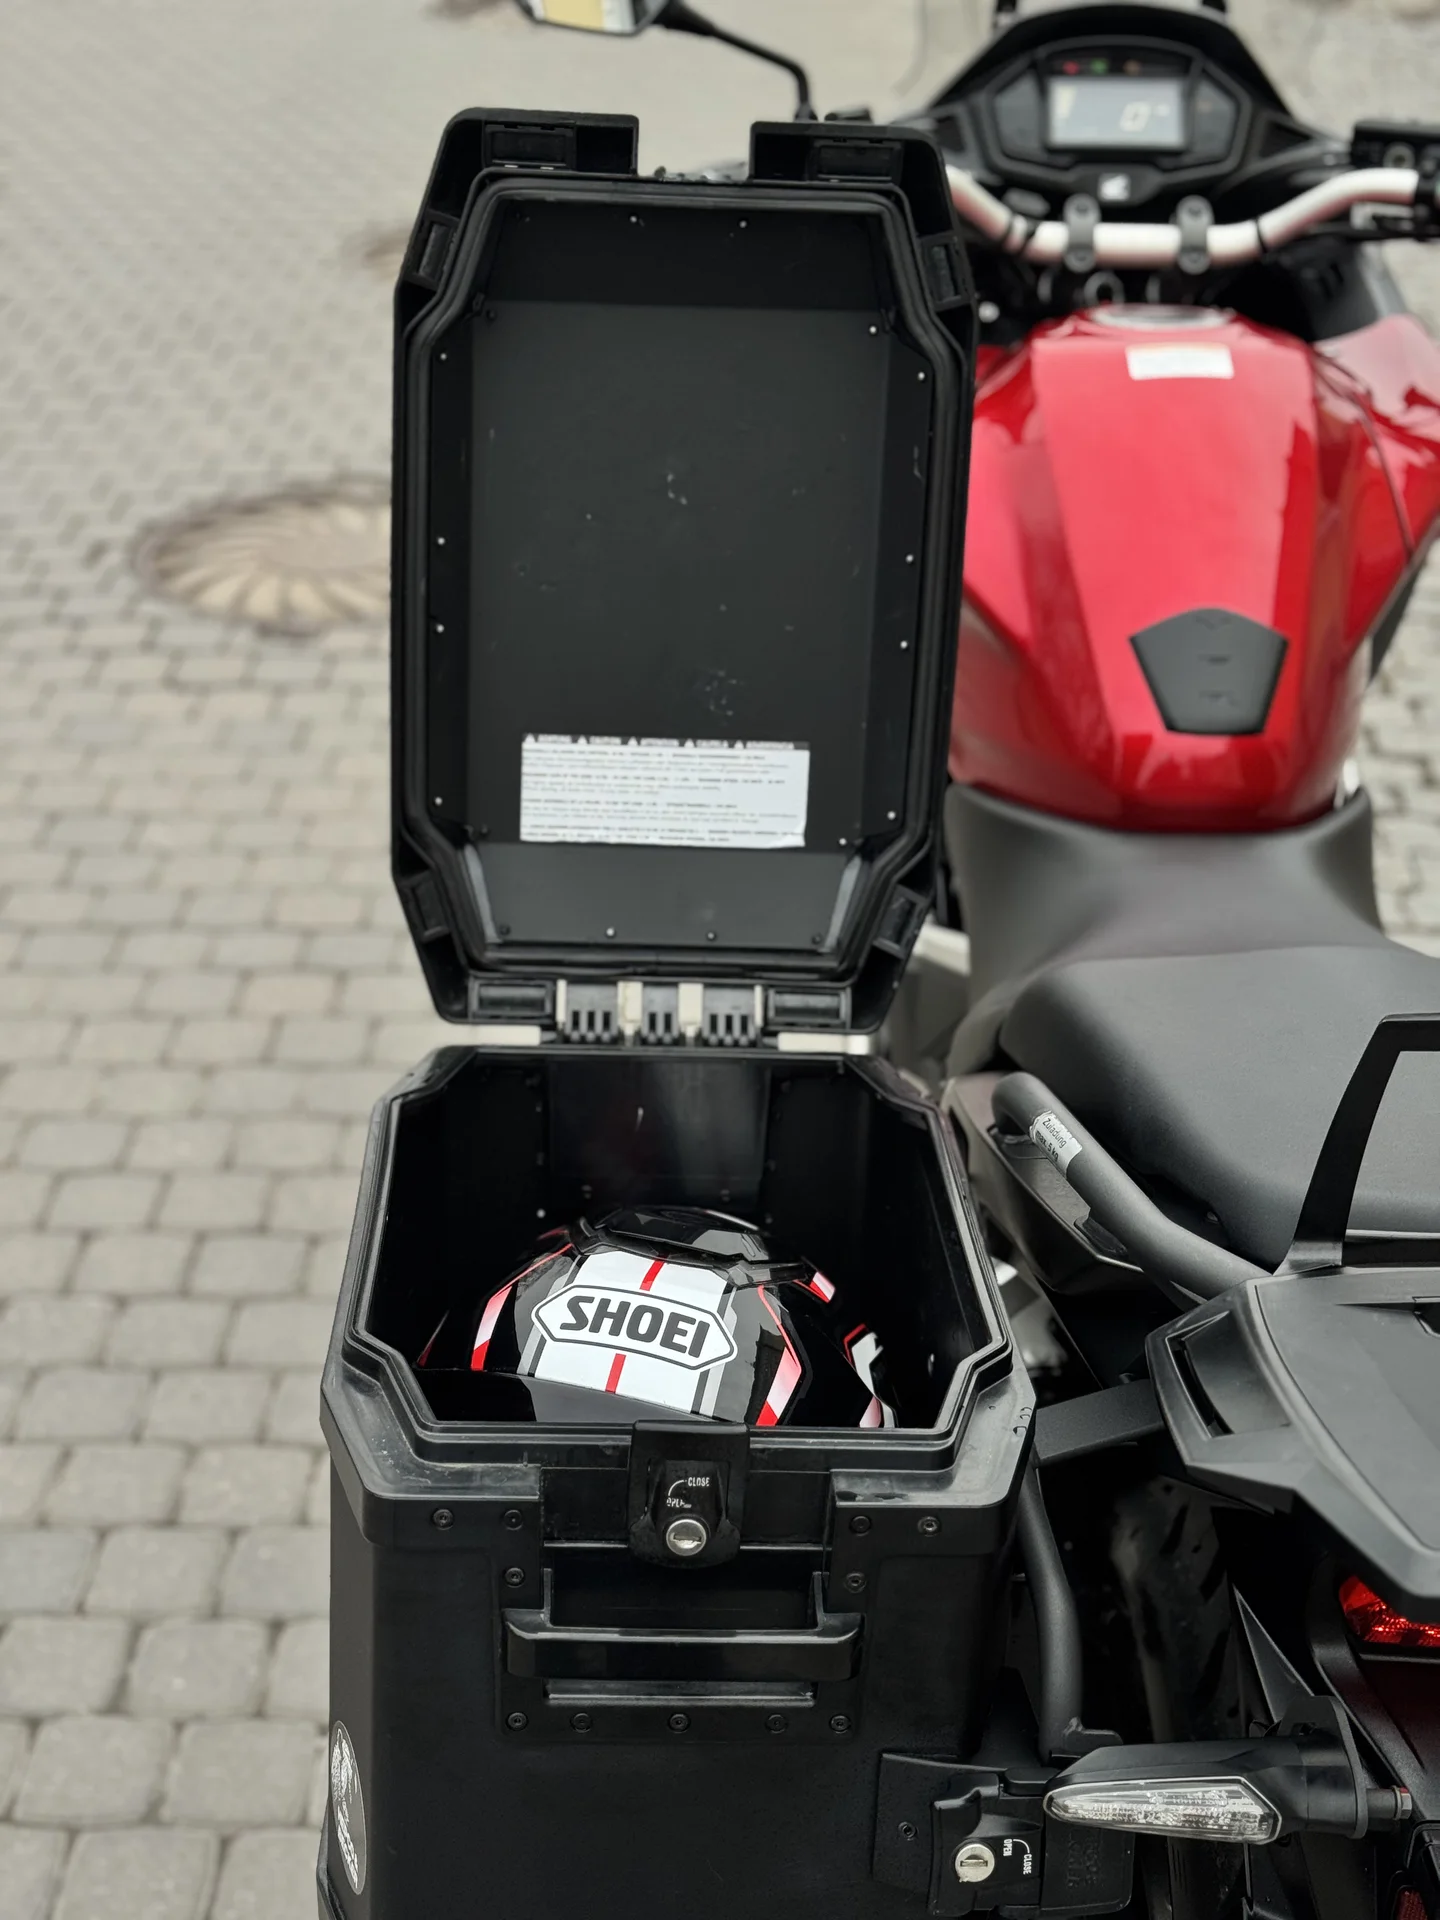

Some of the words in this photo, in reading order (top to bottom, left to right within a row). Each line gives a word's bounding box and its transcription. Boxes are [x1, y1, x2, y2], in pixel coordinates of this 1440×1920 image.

[1042, 1117, 1067, 1149] Zuladung
[559, 1295, 711, 1359] SHOEI
[687, 1476, 710, 1487] CLOSE
[1003, 1838, 1013, 1857] OPEN
[1022, 1853, 1032, 1875] CLOSE
